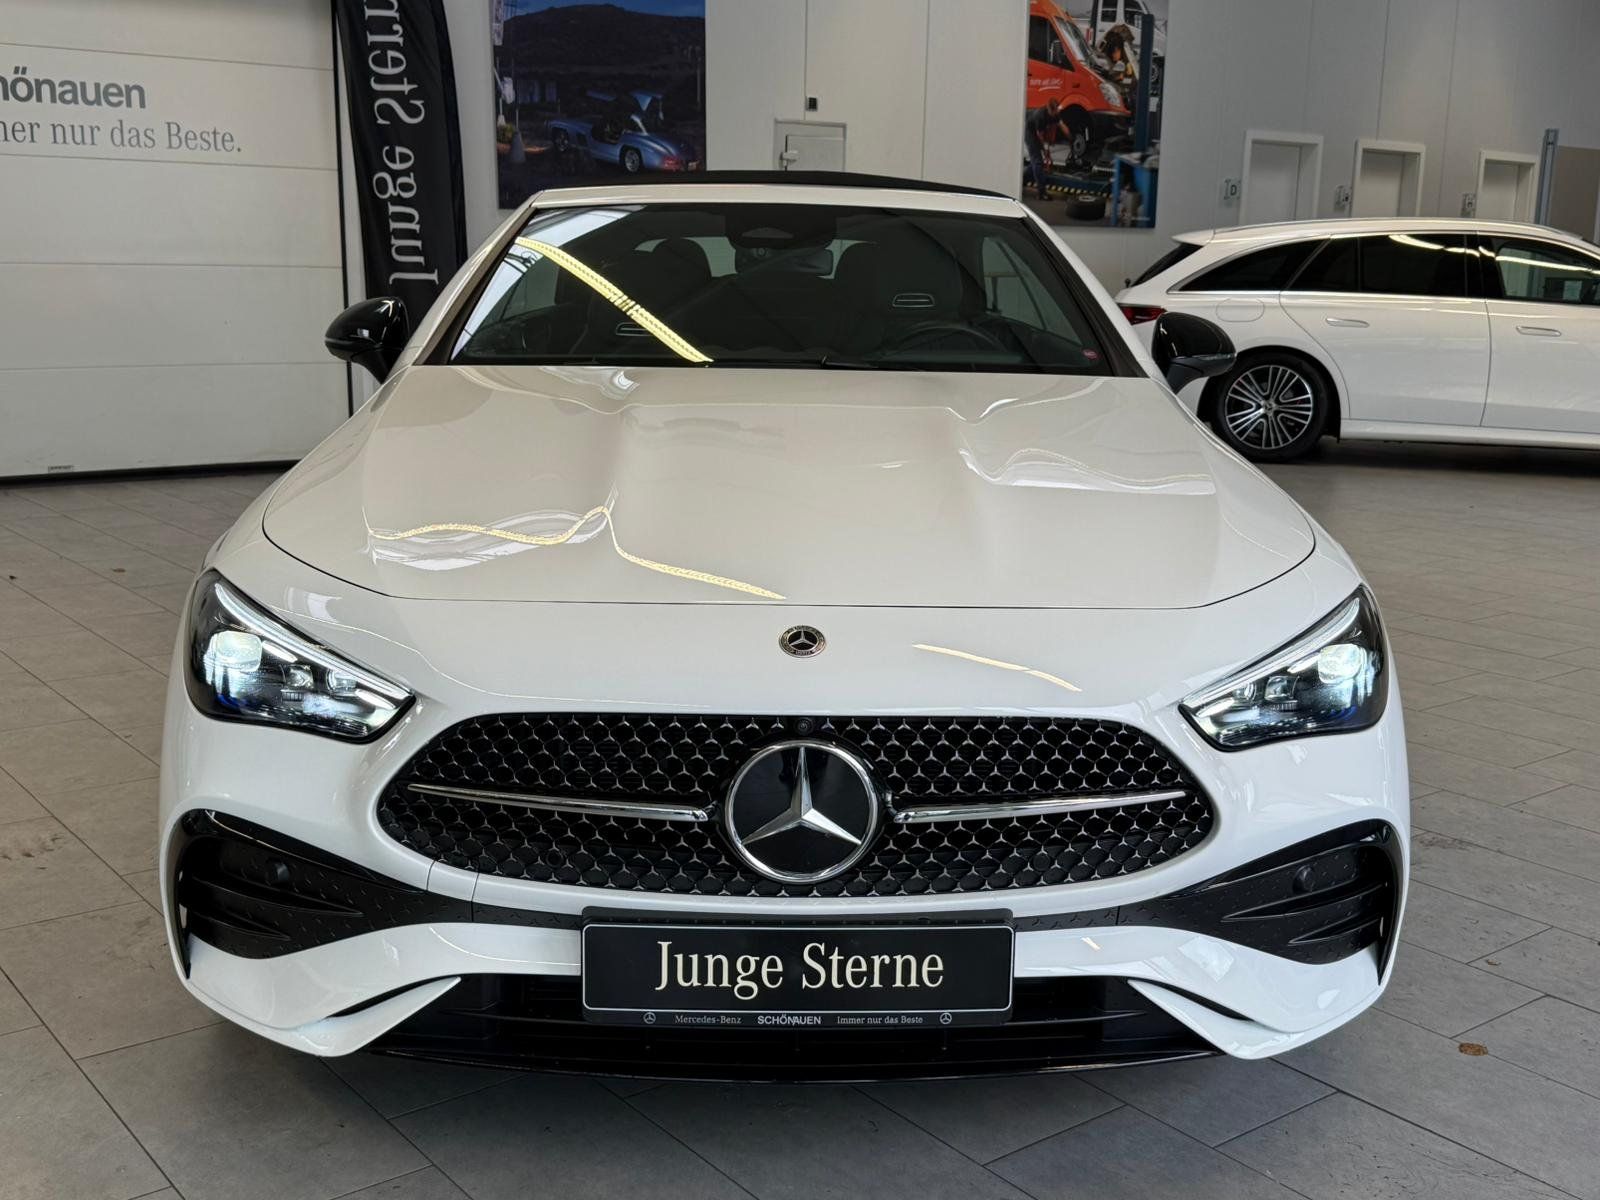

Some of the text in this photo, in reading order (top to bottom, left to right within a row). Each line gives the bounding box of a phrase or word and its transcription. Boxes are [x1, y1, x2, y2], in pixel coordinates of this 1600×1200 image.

[50, 122, 101, 146] nur
[110, 119, 156, 149] das
[164, 121, 242, 152] Beste.
[655, 941, 944, 1000] Junge Sterne
[675, 1015, 742, 1024] Mercedes-Benz
[837, 1015, 865, 1024] Immer
[884, 1015, 899, 1024] das
[901, 1015, 923, 1024] Beste
